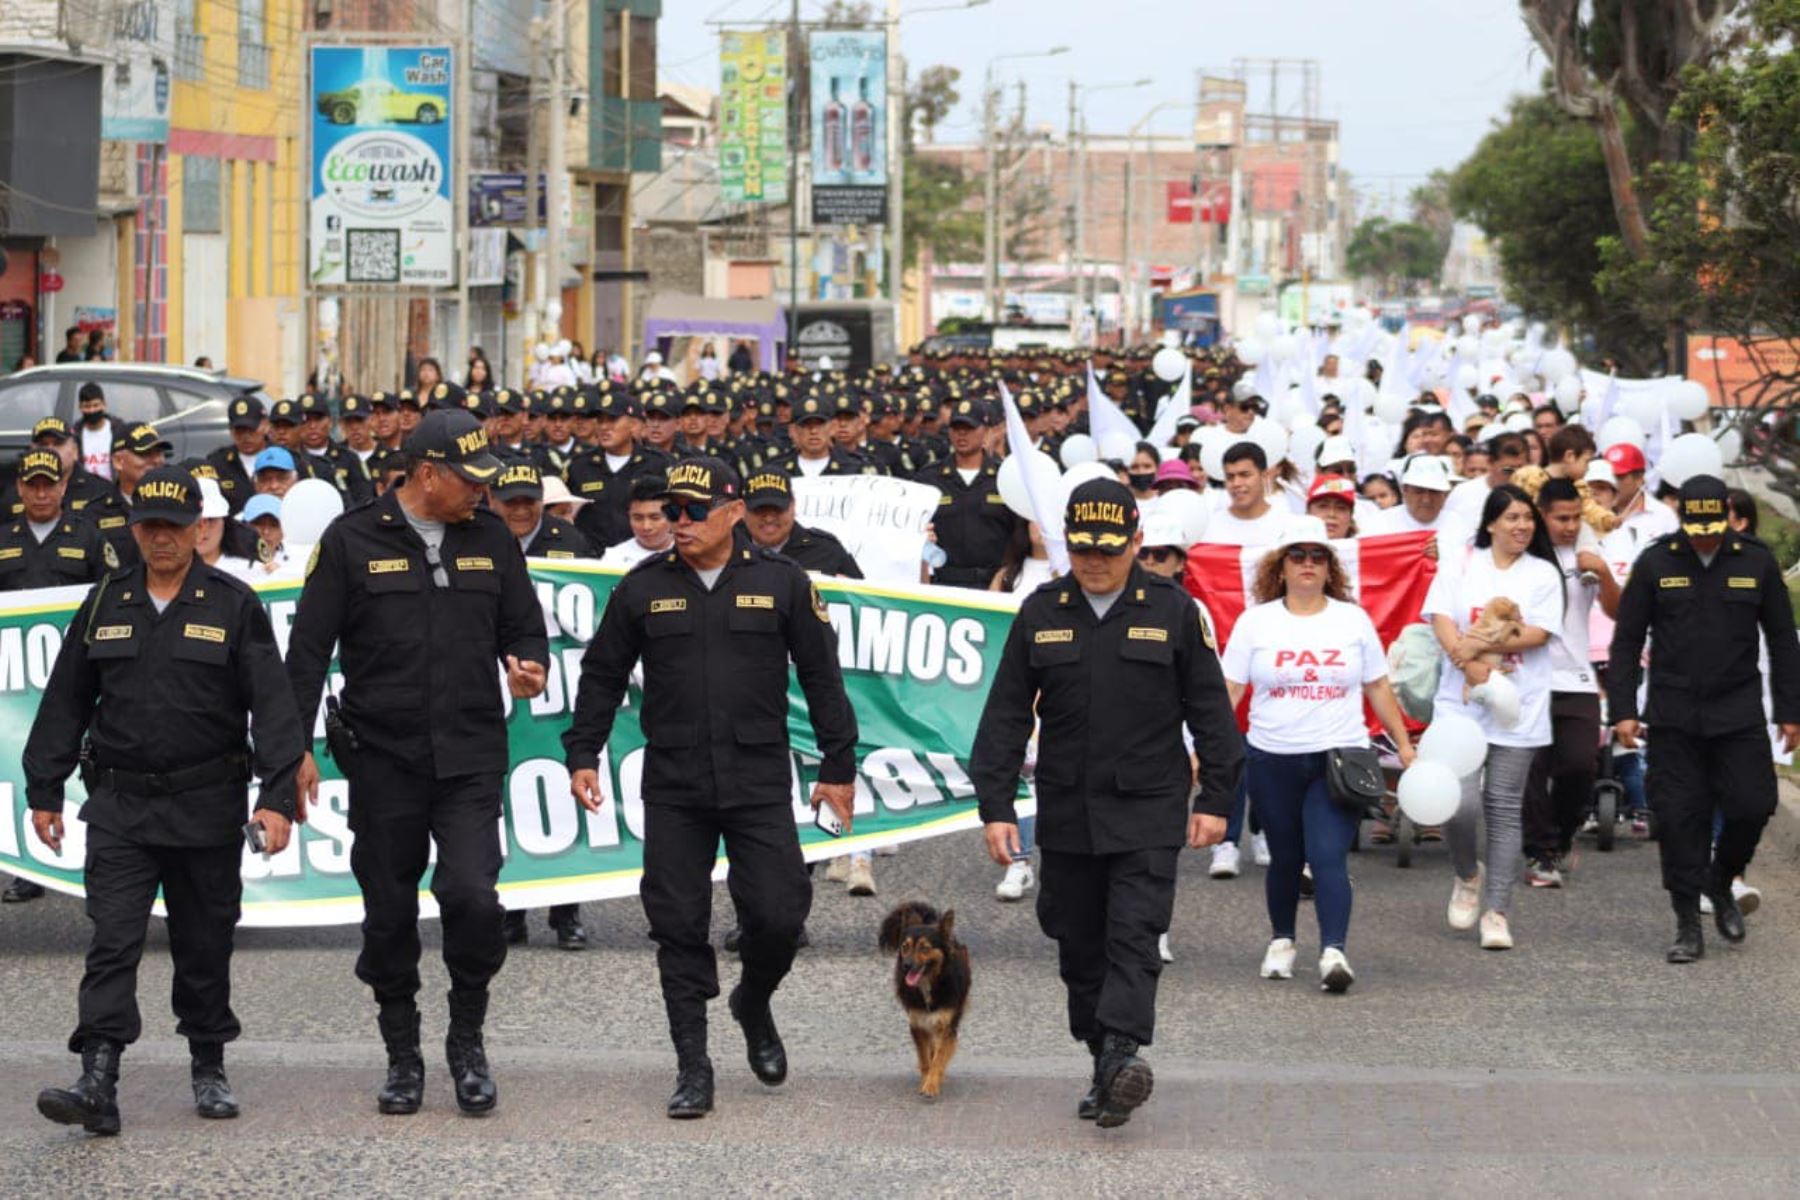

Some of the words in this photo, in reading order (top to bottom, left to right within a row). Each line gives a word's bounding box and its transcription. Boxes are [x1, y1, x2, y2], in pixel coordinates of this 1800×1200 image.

[421, 54, 446, 68] Car
[406, 68, 447, 82] Wash
[326, 154, 436, 182] Ecowash
[24, 450, 58, 469] POLICIA
[666, 464, 711, 490] POLICIA
[748, 473, 787, 493] POLICIA
[138, 481, 188, 504] POLICIA
[1074, 502, 1126, 525] POLICIA
[1685, 499, 1723, 515] POLICIA
[1274, 649, 1346, 668] PAZ
[1303, 668, 1319, 682] &
